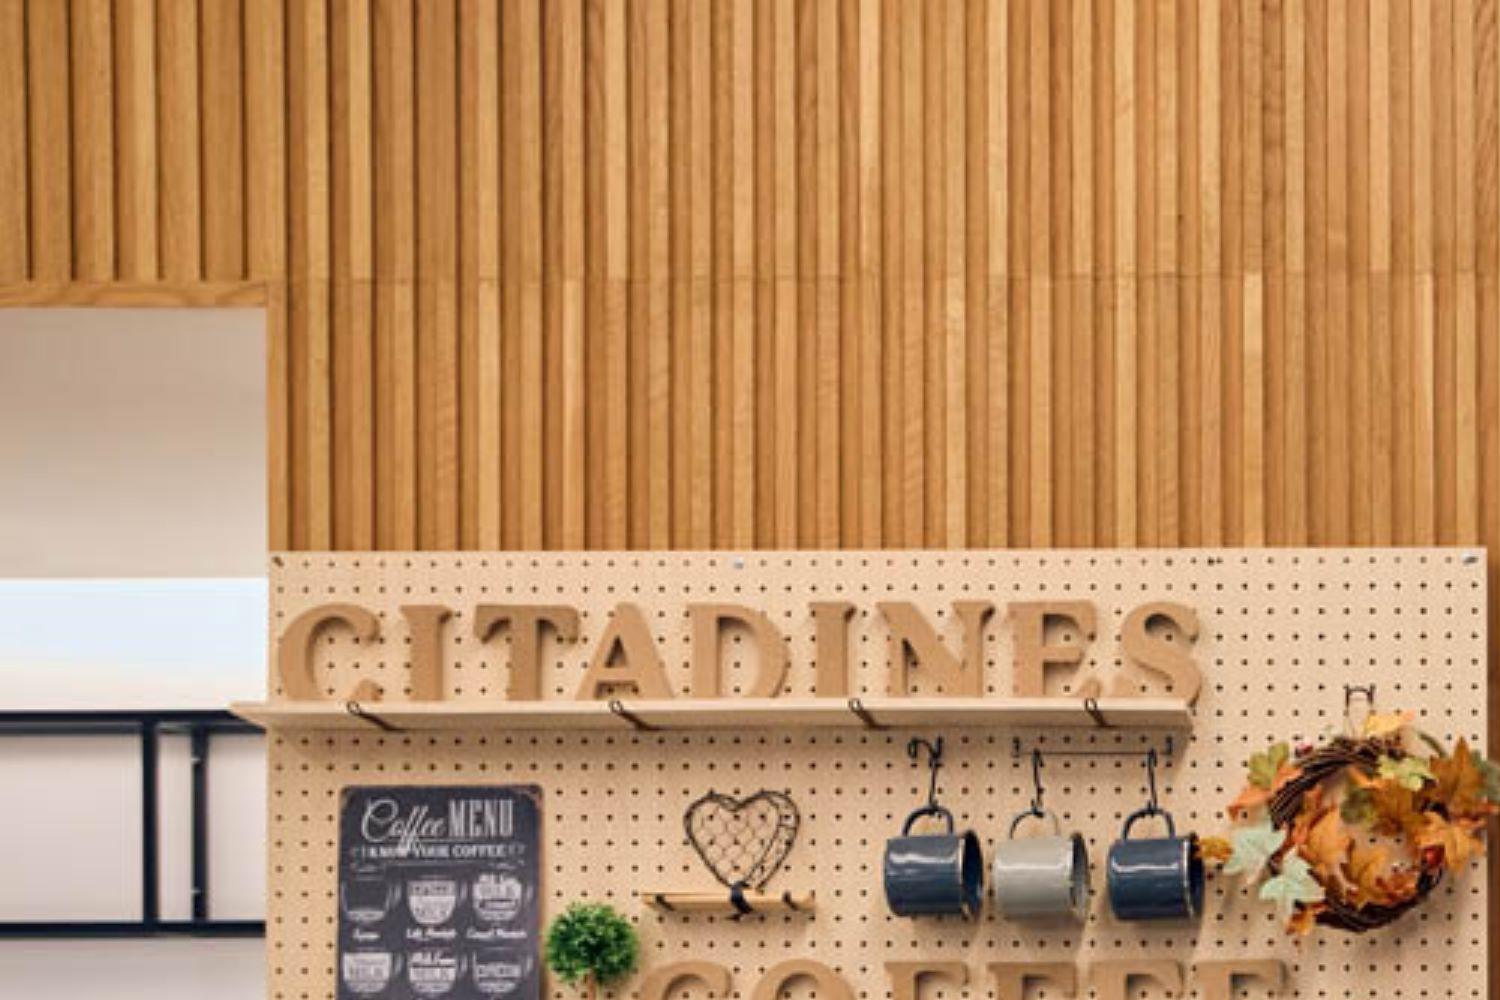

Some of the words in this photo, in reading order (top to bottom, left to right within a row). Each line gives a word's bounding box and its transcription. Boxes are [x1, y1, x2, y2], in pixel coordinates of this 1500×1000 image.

[278, 601, 1203, 702] CITADINES
[361, 799, 447, 851] Coffee
[449, 799, 513, 837] MENU
[452, 844, 506, 857] COFFEE
